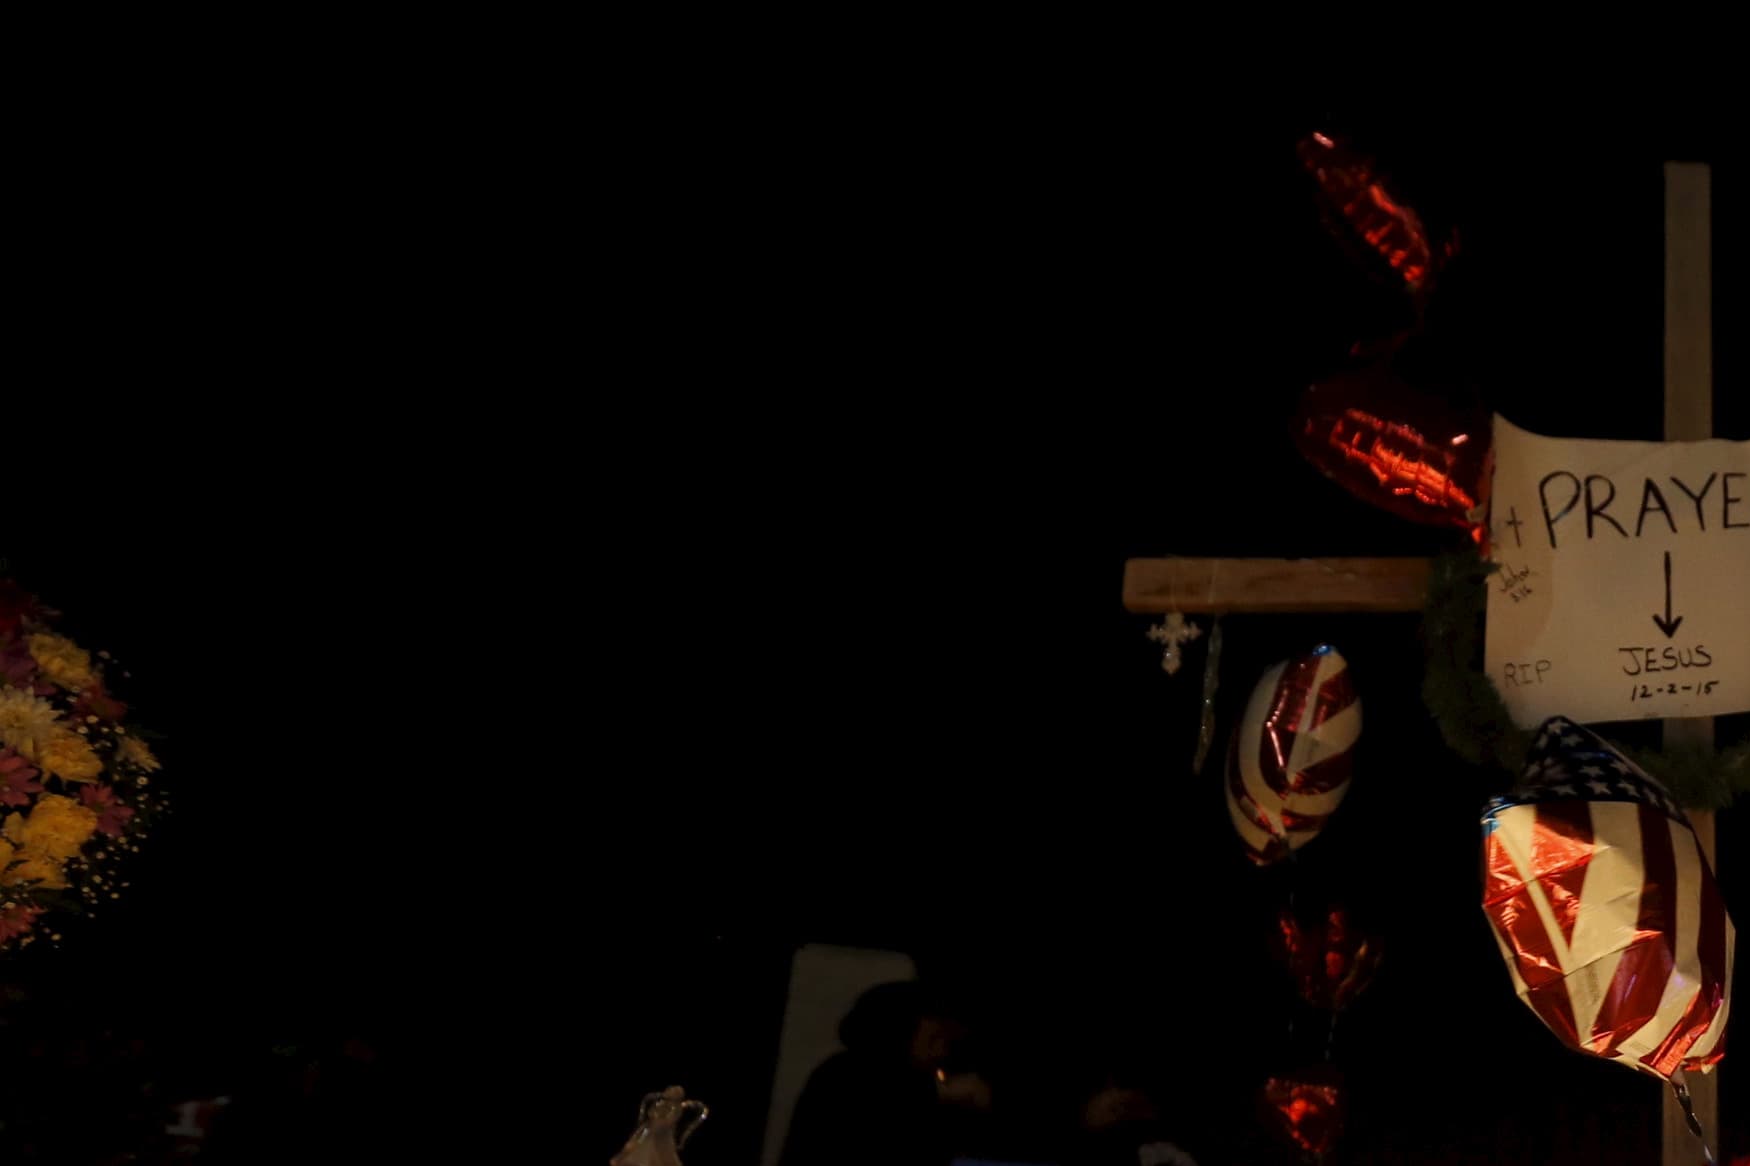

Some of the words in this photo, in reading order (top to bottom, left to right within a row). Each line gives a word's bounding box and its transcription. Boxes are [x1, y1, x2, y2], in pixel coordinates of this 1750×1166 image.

[1503, 659, 1551, 688] RIP
[1618, 645, 1713, 676] JESUS
[1631, 680, 1720, 701] 12-2-15
